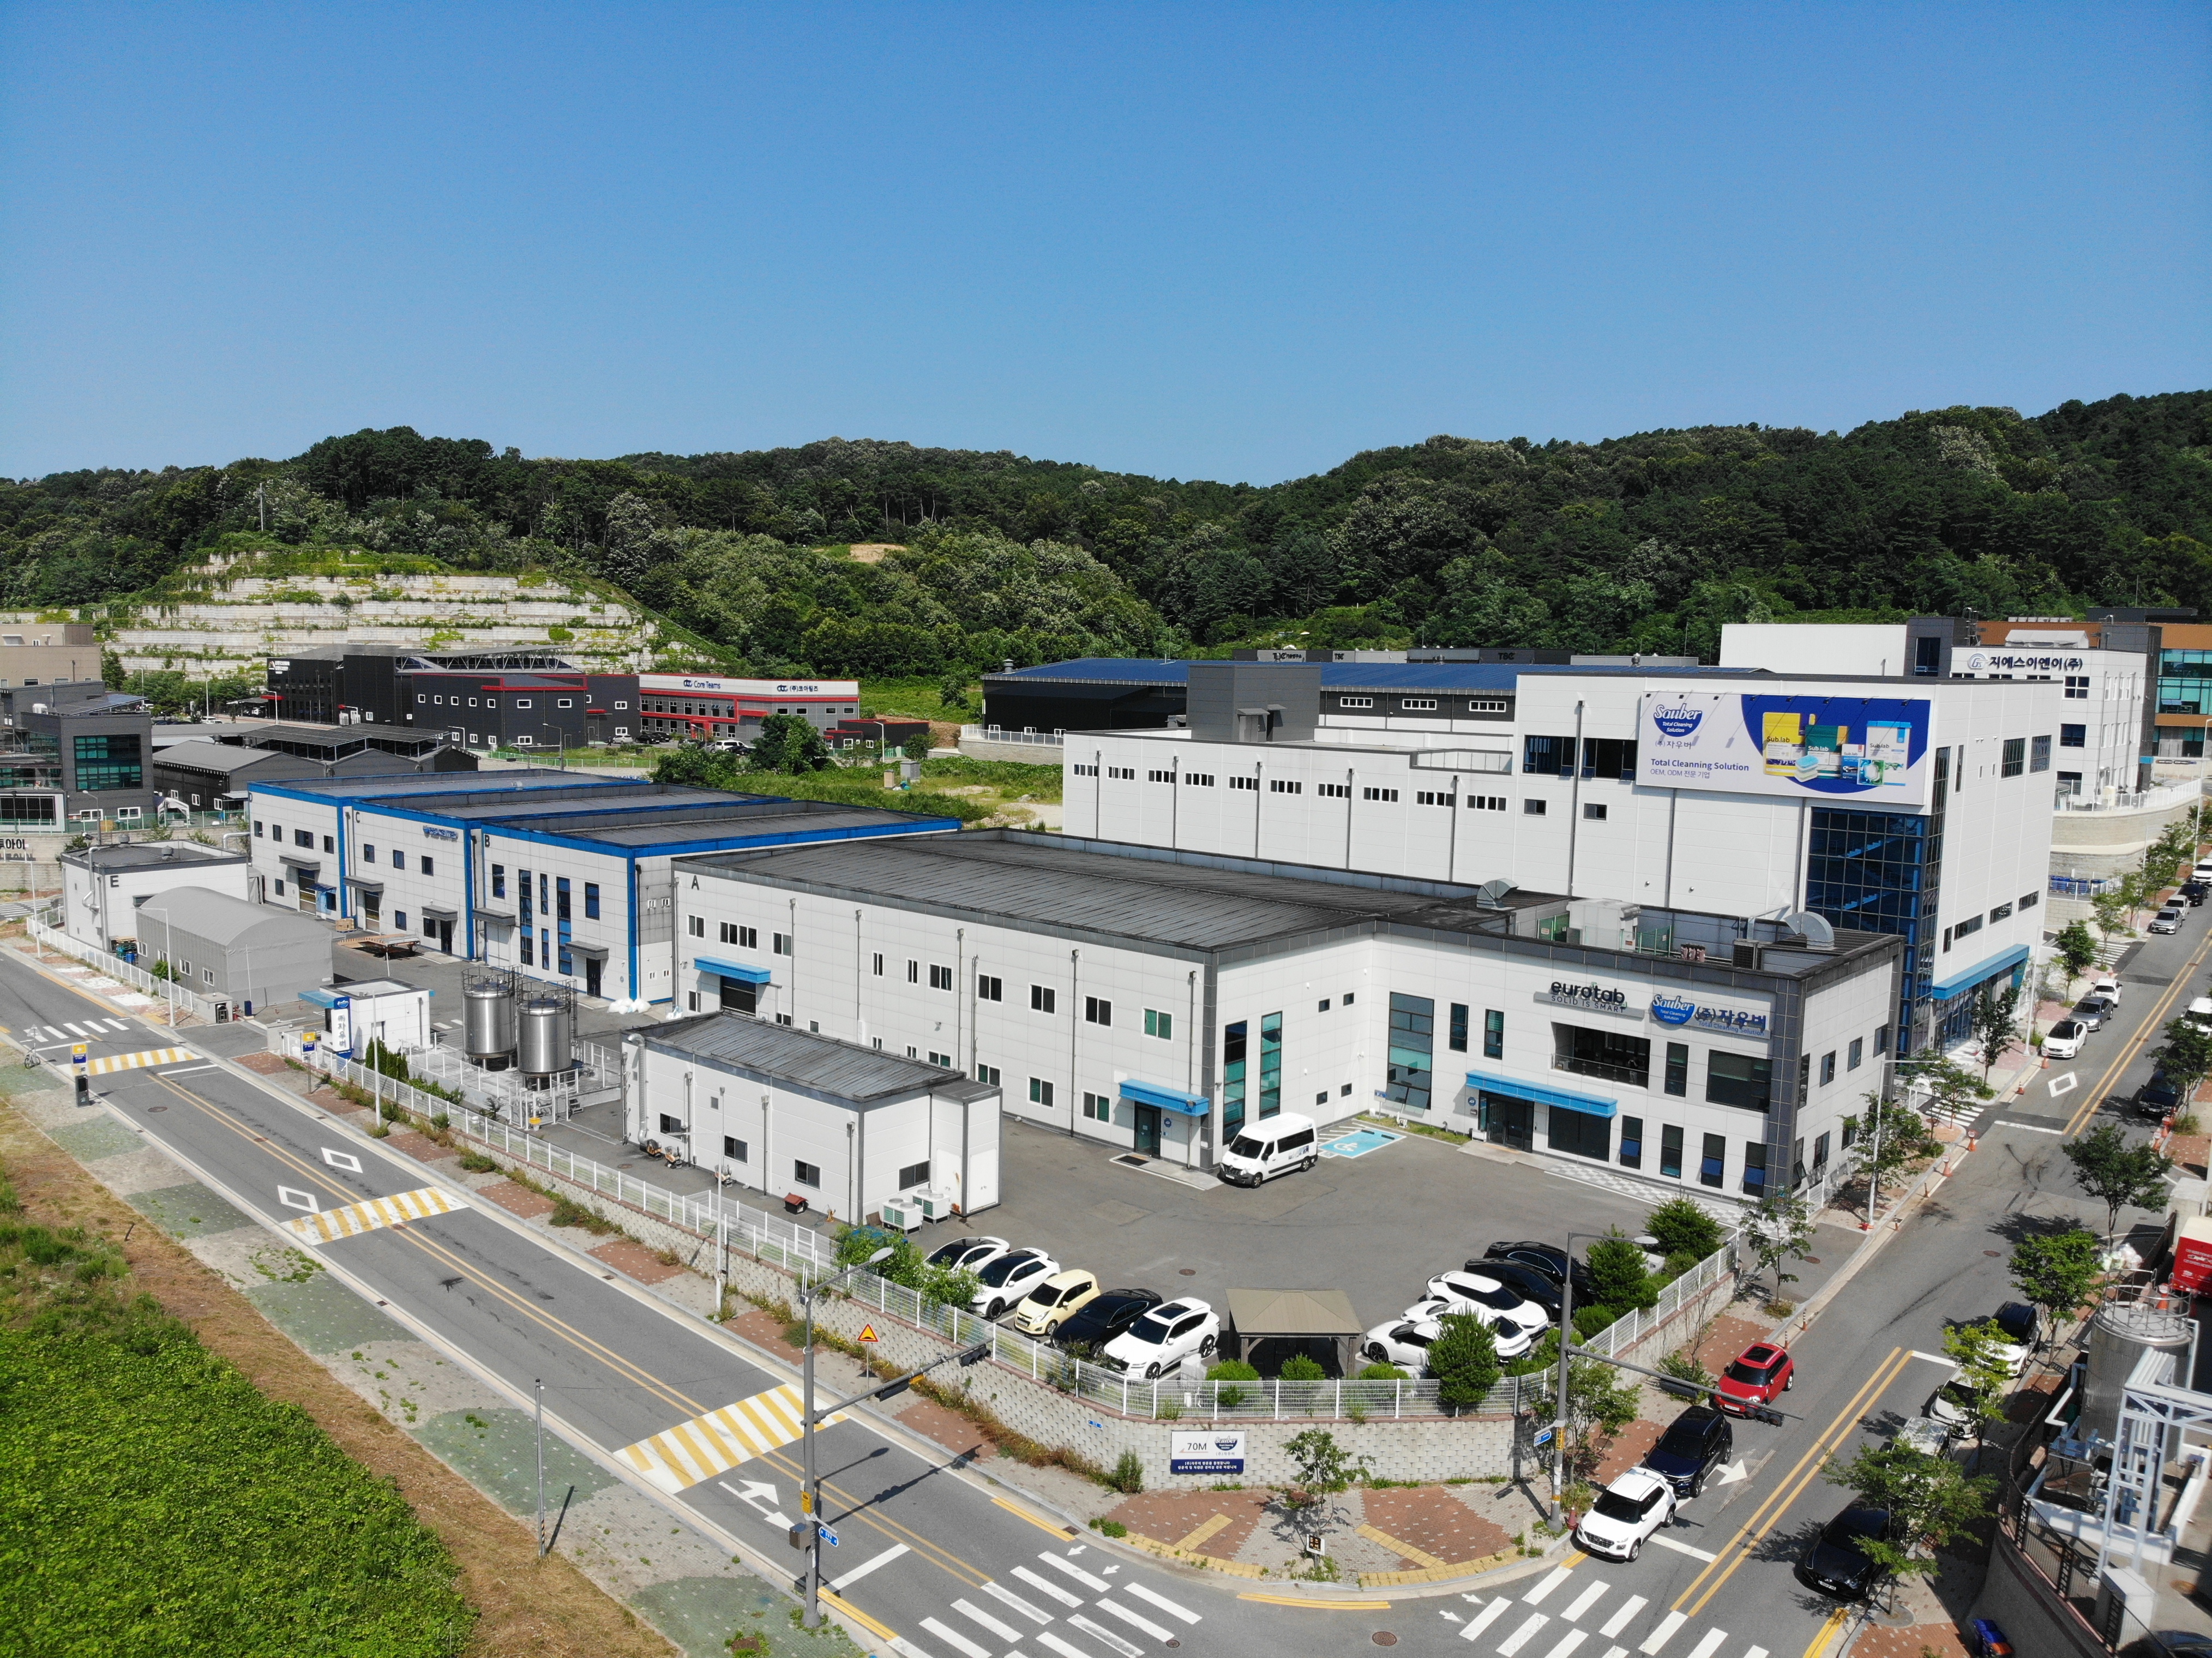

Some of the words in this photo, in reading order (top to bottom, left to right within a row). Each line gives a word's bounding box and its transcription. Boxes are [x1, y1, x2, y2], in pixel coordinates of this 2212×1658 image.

[1654, 703, 1702, 720] Sauber
[1672, 760, 1712, 771] Cleanning
[1714, 762, 1749, 771] Solution
[356, 812, 360, 823] C
[485, 834, 490, 848] B
[110, 875, 119, 887] E
[692, 875, 699, 890] A
[1551, 982, 1625, 1004] eurotab
[1552, 995, 1578, 1005] SOLID
[1595, 1003, 1624, 1013] SMART
[1652, 994, 1694, 1011] Sauber
[1714, 1024, 1738, 1033] Cleaning
[1215, 1435, 1237, 1444] Sauber
